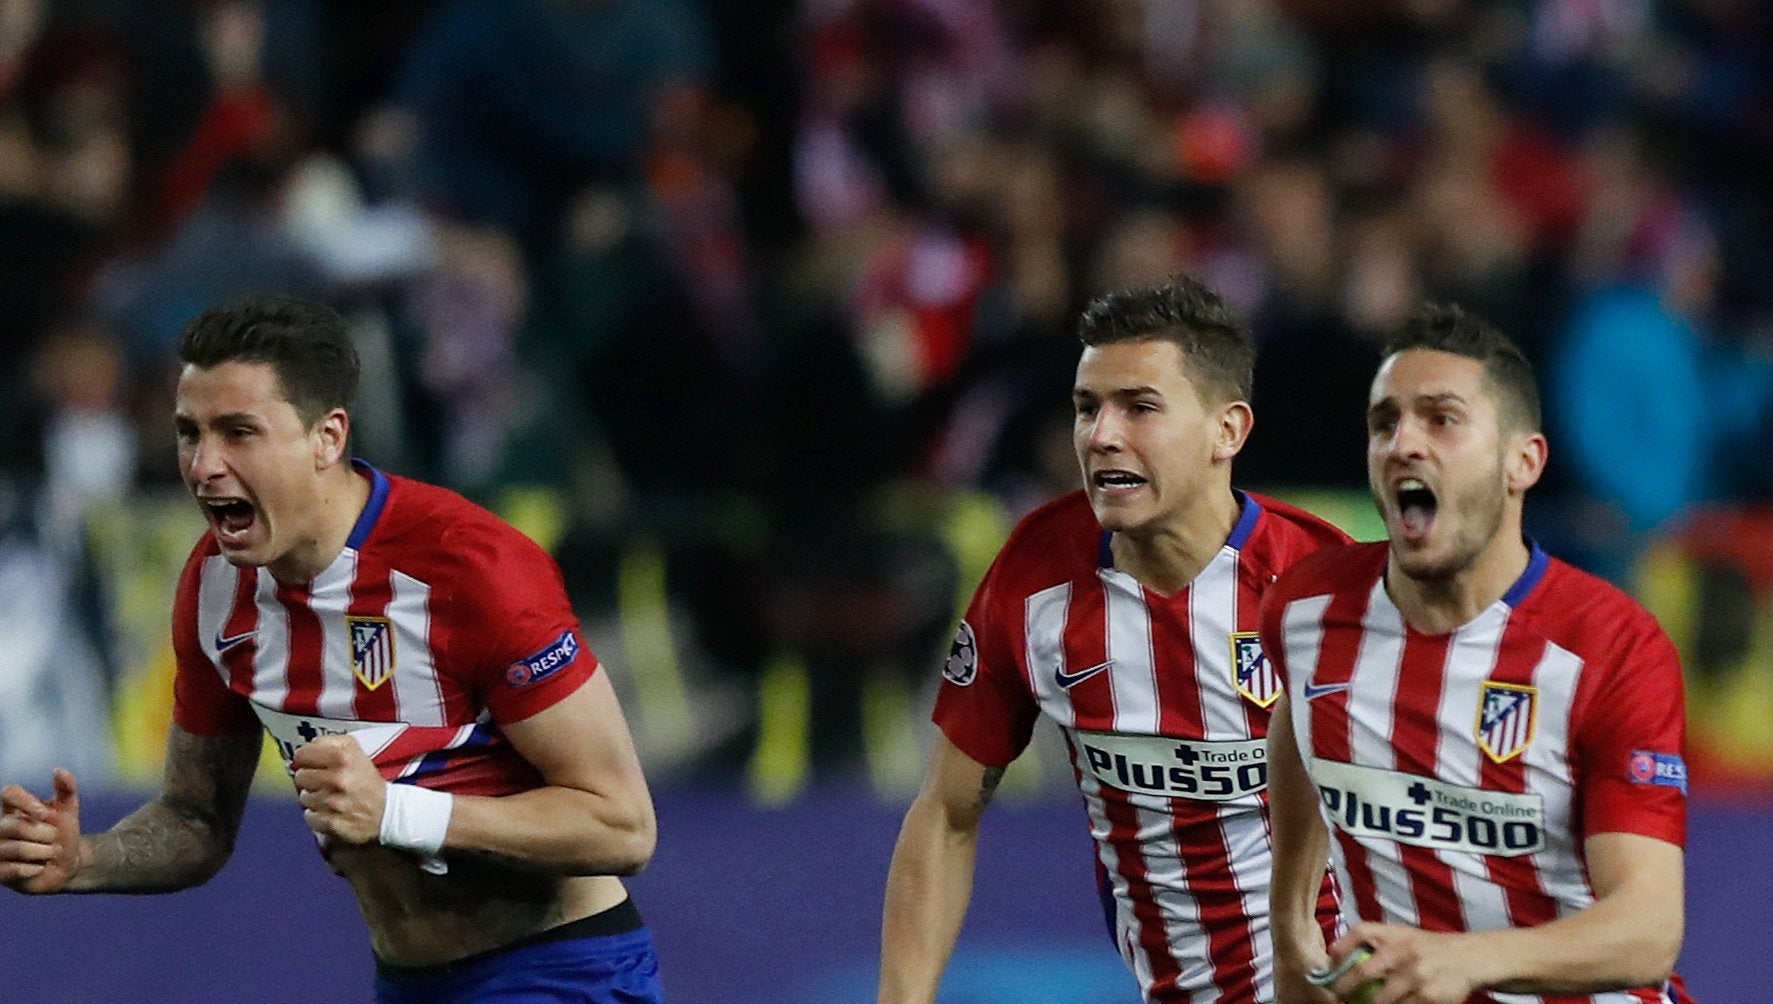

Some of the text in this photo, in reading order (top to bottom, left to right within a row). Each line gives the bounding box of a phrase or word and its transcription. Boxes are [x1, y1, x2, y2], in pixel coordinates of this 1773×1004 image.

[1083, 744, 1267, 796] Plus50
[1200, 749, 1249, 763] Trade
[1432, 788, 1538, 819] Trade Online
